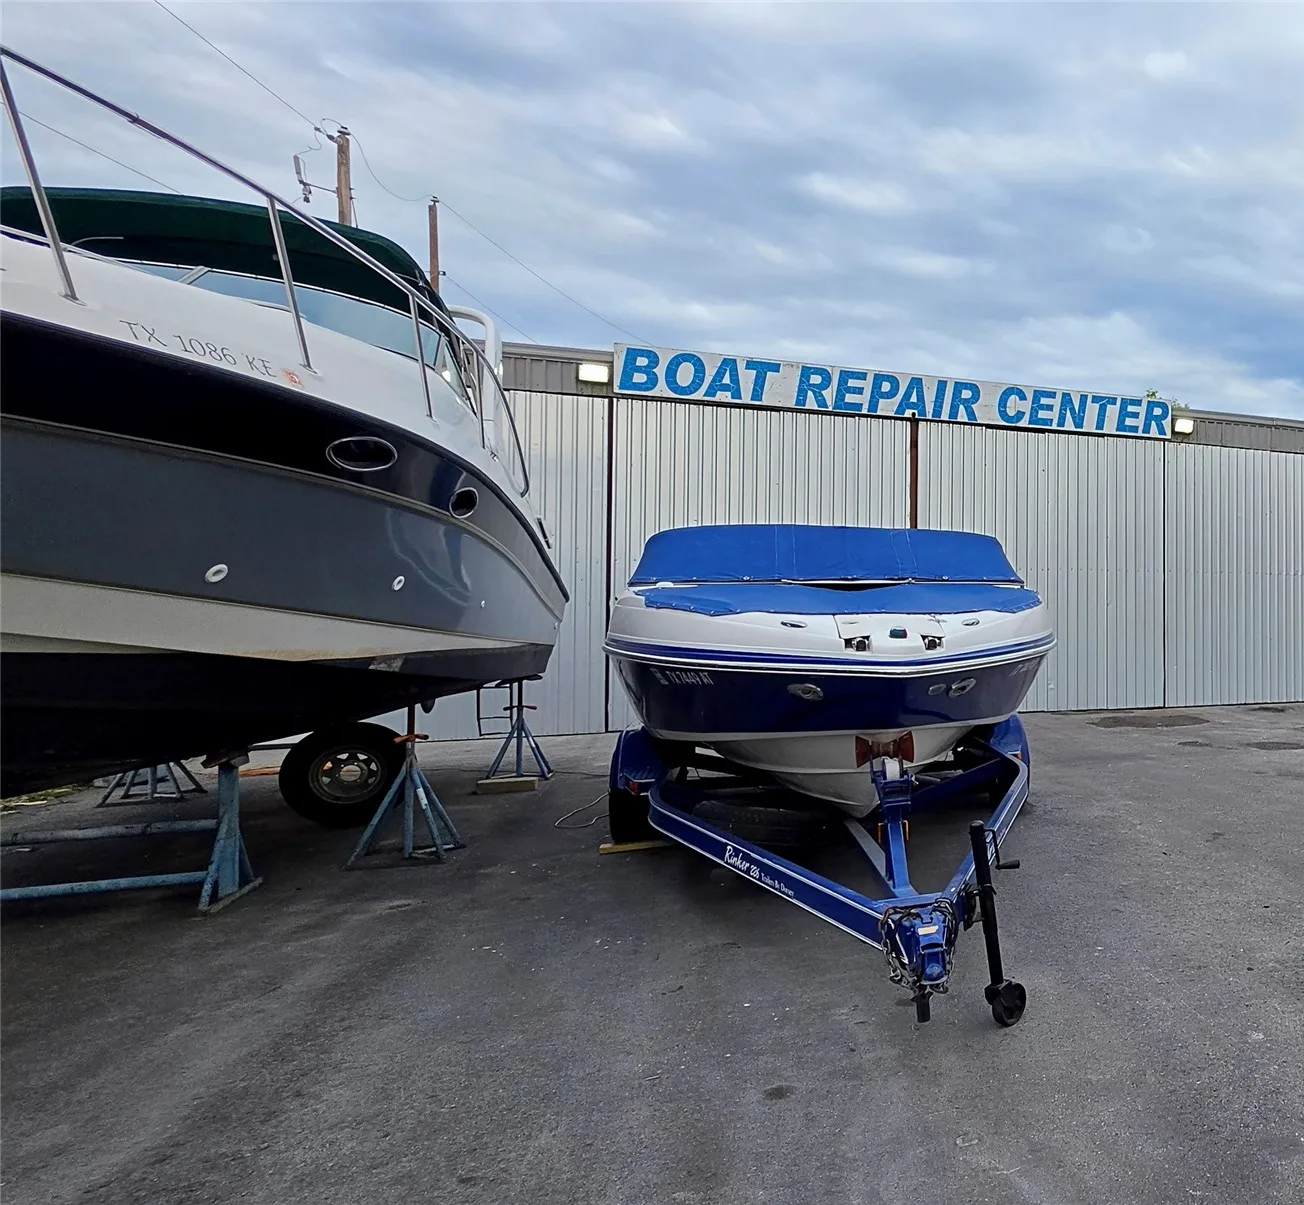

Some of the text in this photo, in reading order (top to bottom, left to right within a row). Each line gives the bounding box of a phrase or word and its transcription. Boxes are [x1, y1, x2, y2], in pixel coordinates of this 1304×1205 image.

[119, 319, 168, 347] TX
[172, 334, 237, 366] 1086
[242, 353, 277, 378] KE
[618, 347, 1170, 437] BOAT REPAIR CENTER
[724, 845, 750, 872] Rinker
